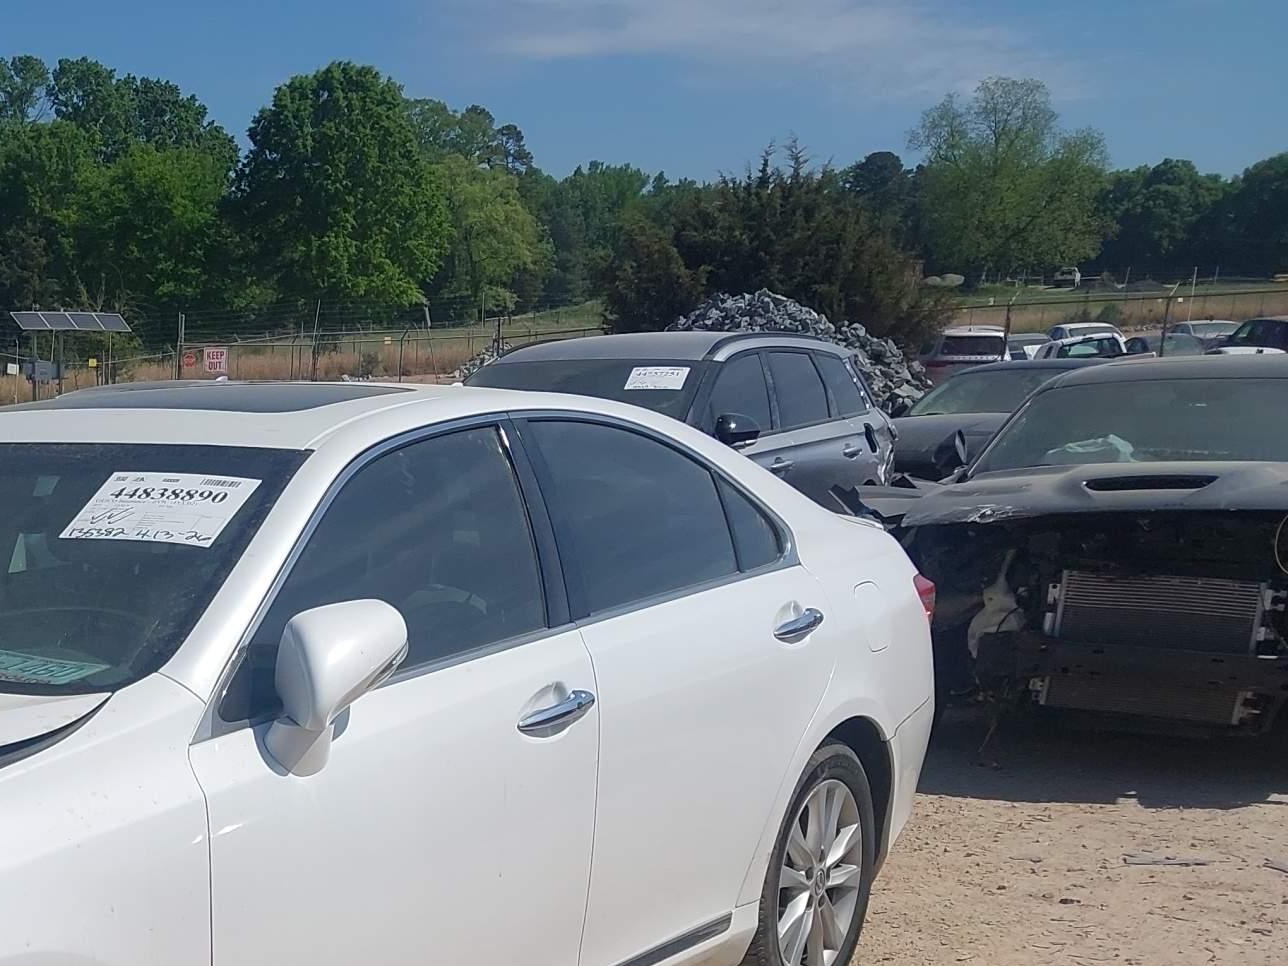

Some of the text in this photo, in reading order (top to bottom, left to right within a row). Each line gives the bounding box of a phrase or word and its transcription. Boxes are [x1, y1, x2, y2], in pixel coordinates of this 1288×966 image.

[207, 351, 224, 361] KEEP
[208, 361, 222, 370] OUT
[110, 486, 229, 504] 44838890
